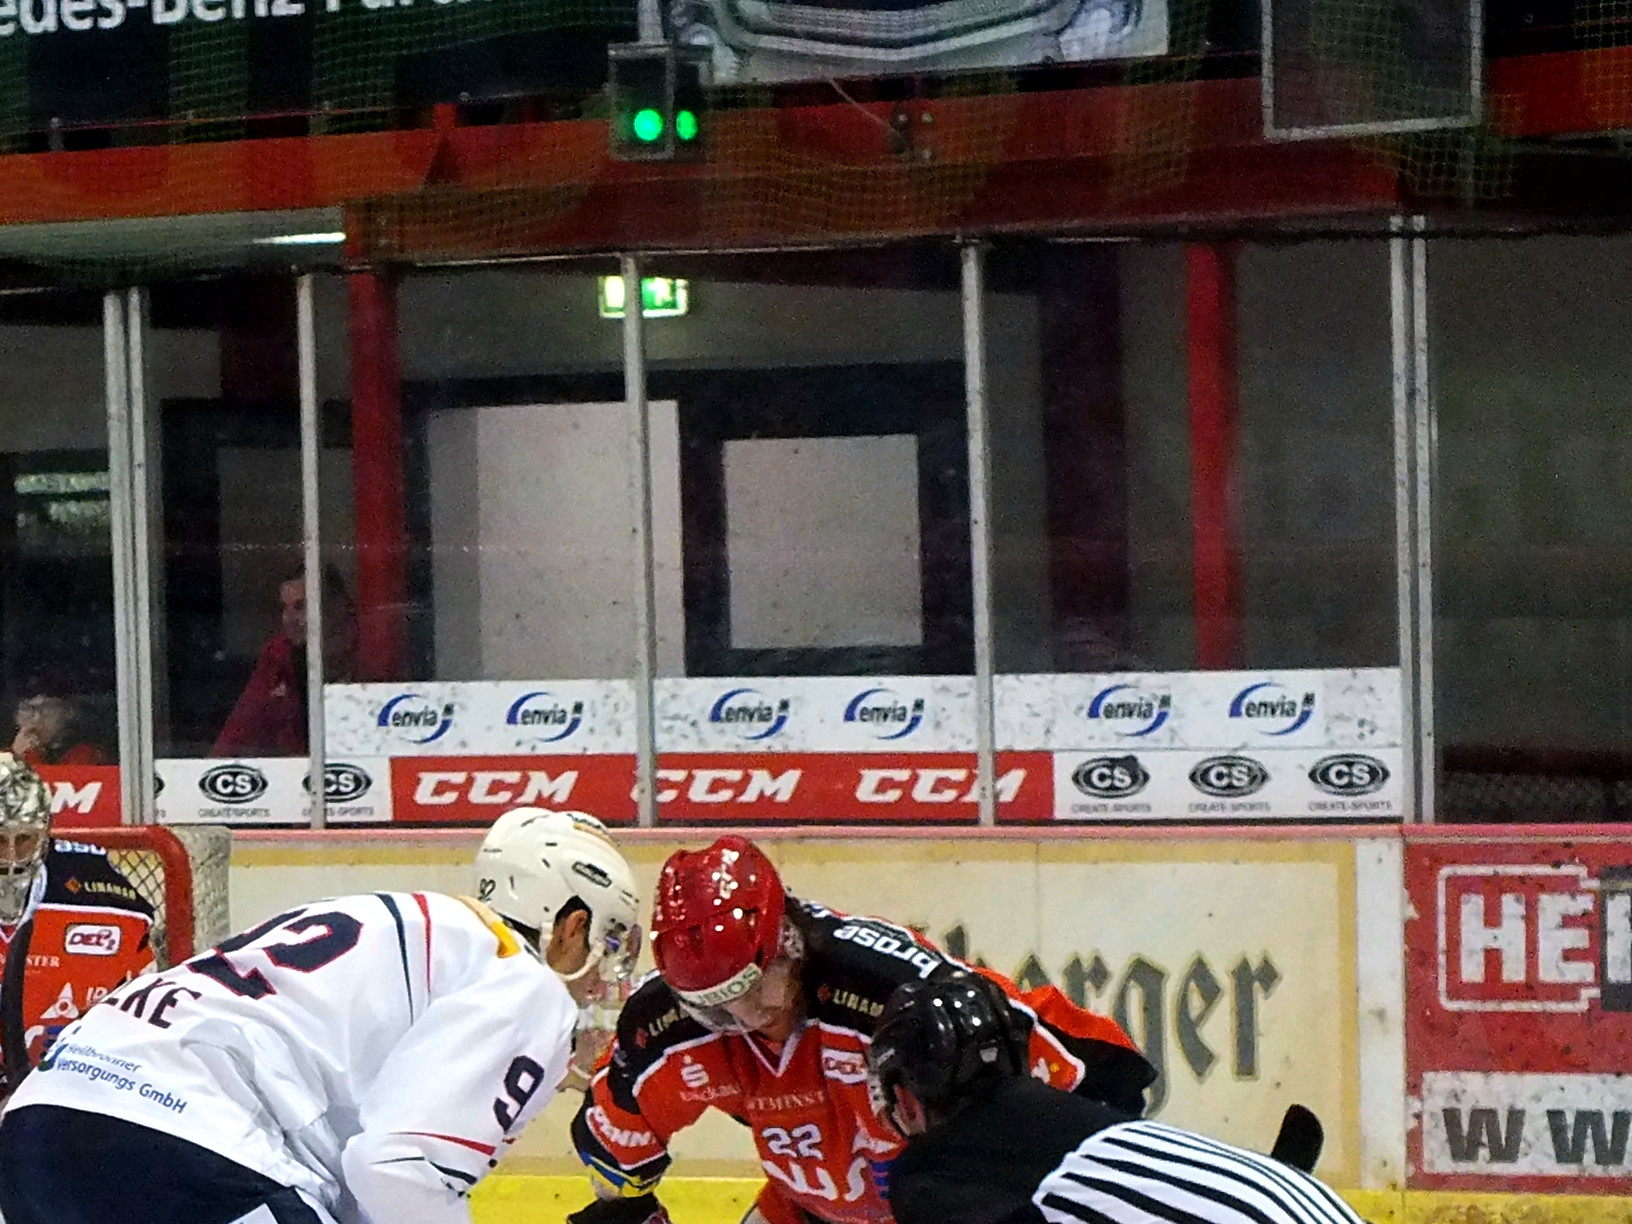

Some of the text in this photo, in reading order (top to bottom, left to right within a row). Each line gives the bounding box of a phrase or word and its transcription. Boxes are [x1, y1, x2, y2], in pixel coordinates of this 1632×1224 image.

[215, 772, 253, 795] CS
[412, 770, 579, 806] CCM
[630, 768, 803, 804] CCM
[855, 768, 1028, 804] CCM
[1089, 768, 1132, 789] CS
[1207, 766, 1250, 788] CS
[1329, 764, 1371, 786] CS
[138, 1082, 188, 1114] GmbH
[762, 1123, 824, 1161] 22
